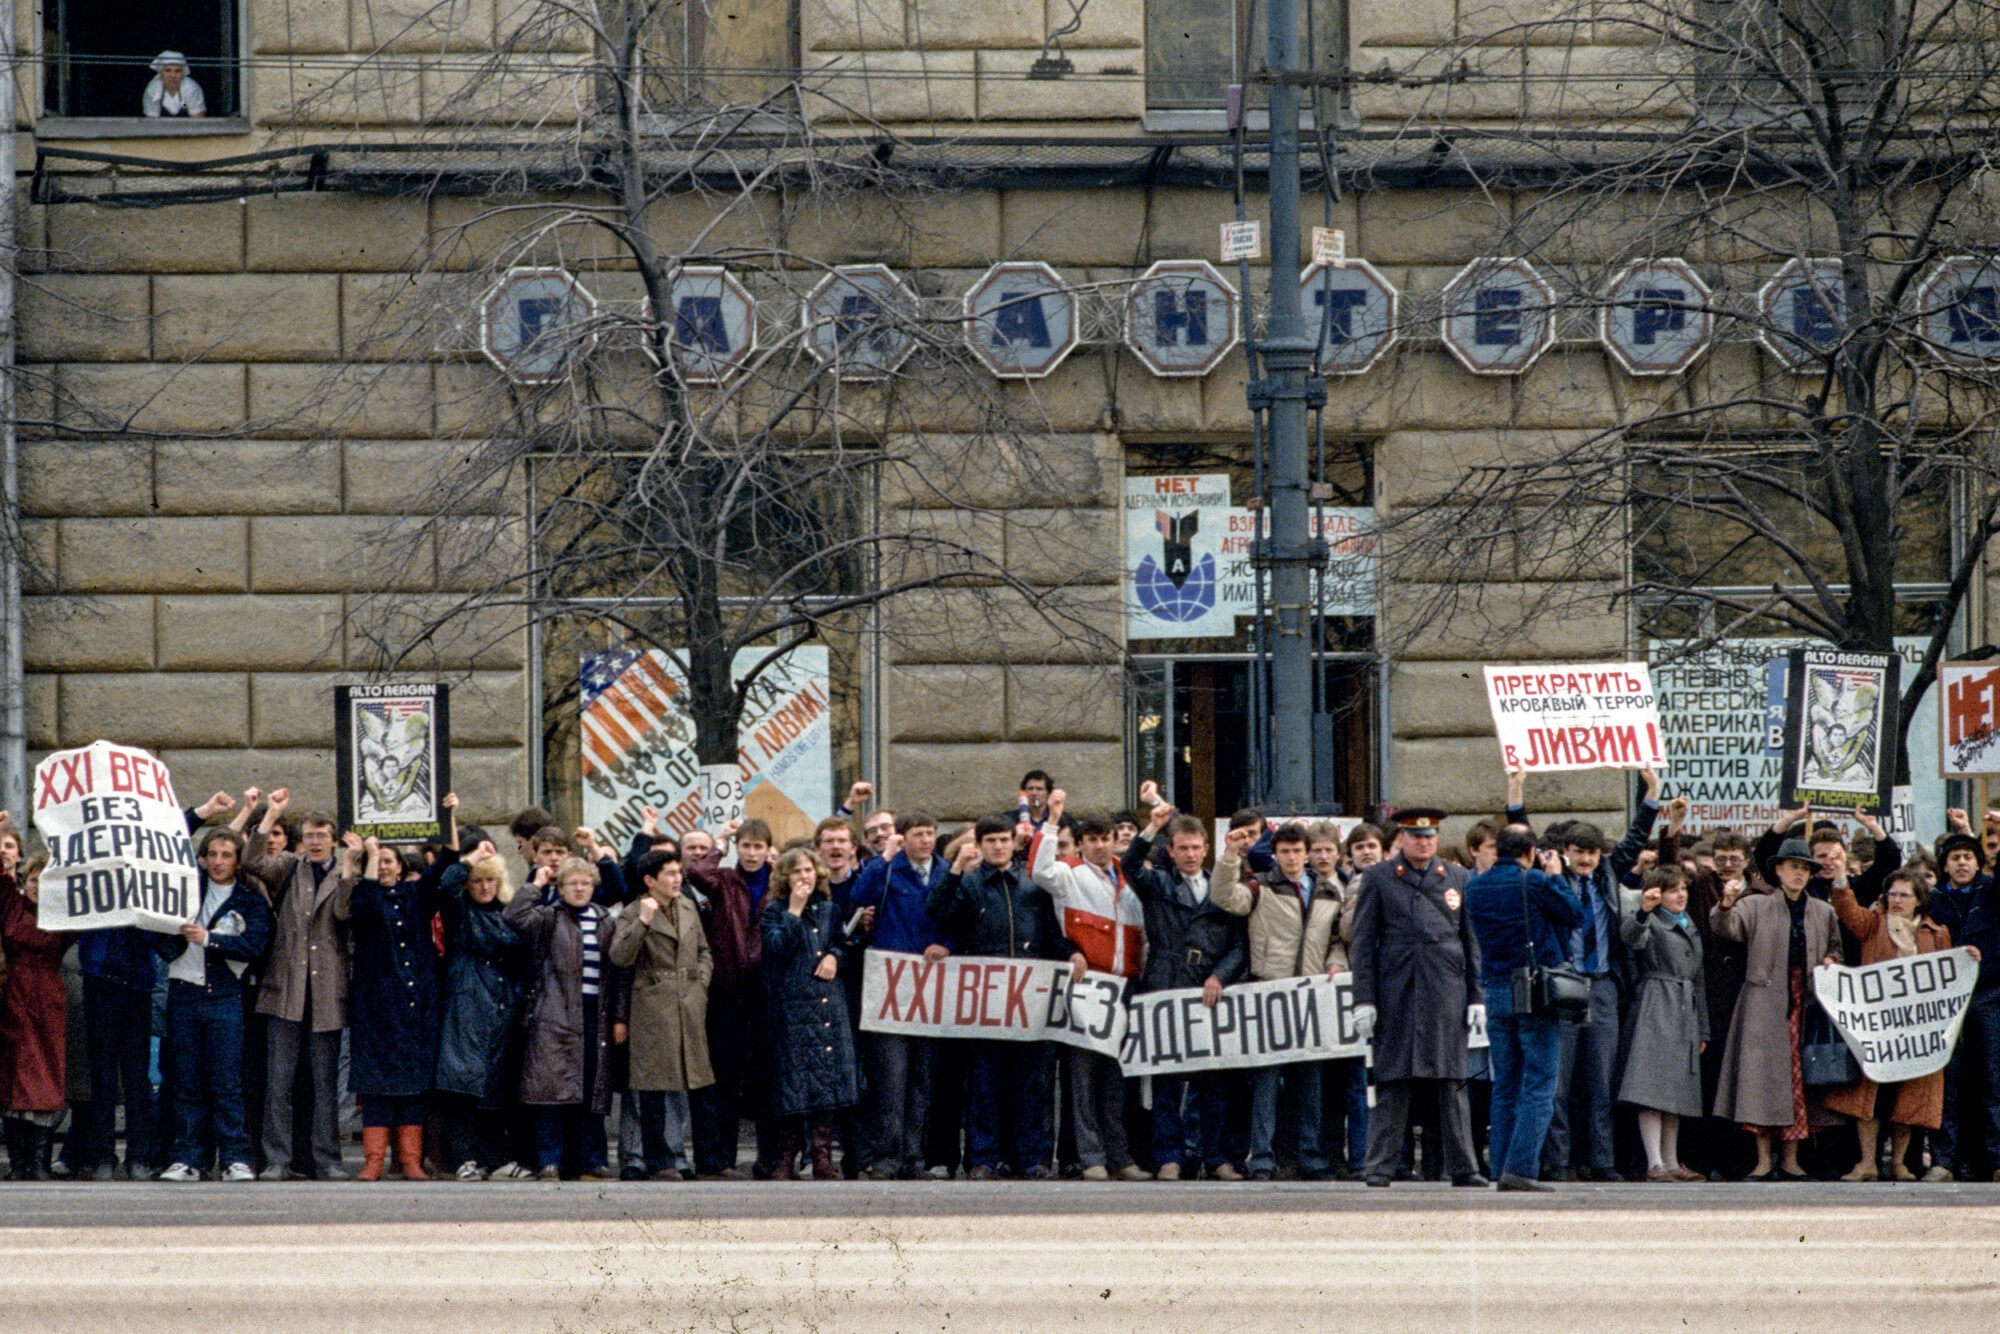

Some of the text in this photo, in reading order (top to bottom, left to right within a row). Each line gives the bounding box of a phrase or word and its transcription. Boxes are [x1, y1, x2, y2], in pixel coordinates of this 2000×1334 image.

[1155, 477, 1200, 493] НЕТ
[1804, 651, 1836, 664] ALTO
[1838, 653, 1889, 667] REAGAN
[1493, 672, 1642, 695] ПРЕКРАТИТЬ
[1657, 669, 1749, 688] ГНЕВНО
[349, 684, 436, 697] ALTO REAGAN
[1501, 695, 1654, 713] КРОВАВЫЙ ТЕРРОР
[1660, 714, 1767, 733] АМЕРИКА
[109, 751, 174, 807] ВЕК
[1659, 759, 1749, 778] ПРОТИВ
[1660, 781, 1780, 800] ДЖАМАХИ
[81, 797, 143, 824] БЕЗ
[1691, 804, 1782, 820] РЕШИТЕЛЬН
[47, 825, 198, 868] ЯДЕРНОЙ
[67, 864, 188, 918] ВОЙНЫ
[878, 957, 945, 1025] XXI
[1838, 957, 1956, 1004] ПОЗОР
[1123, 979, 1321, 1066] ЯДЕРНОЙ
[1838, 993, 1969, 1031] АМЕРИКАНСКИ
